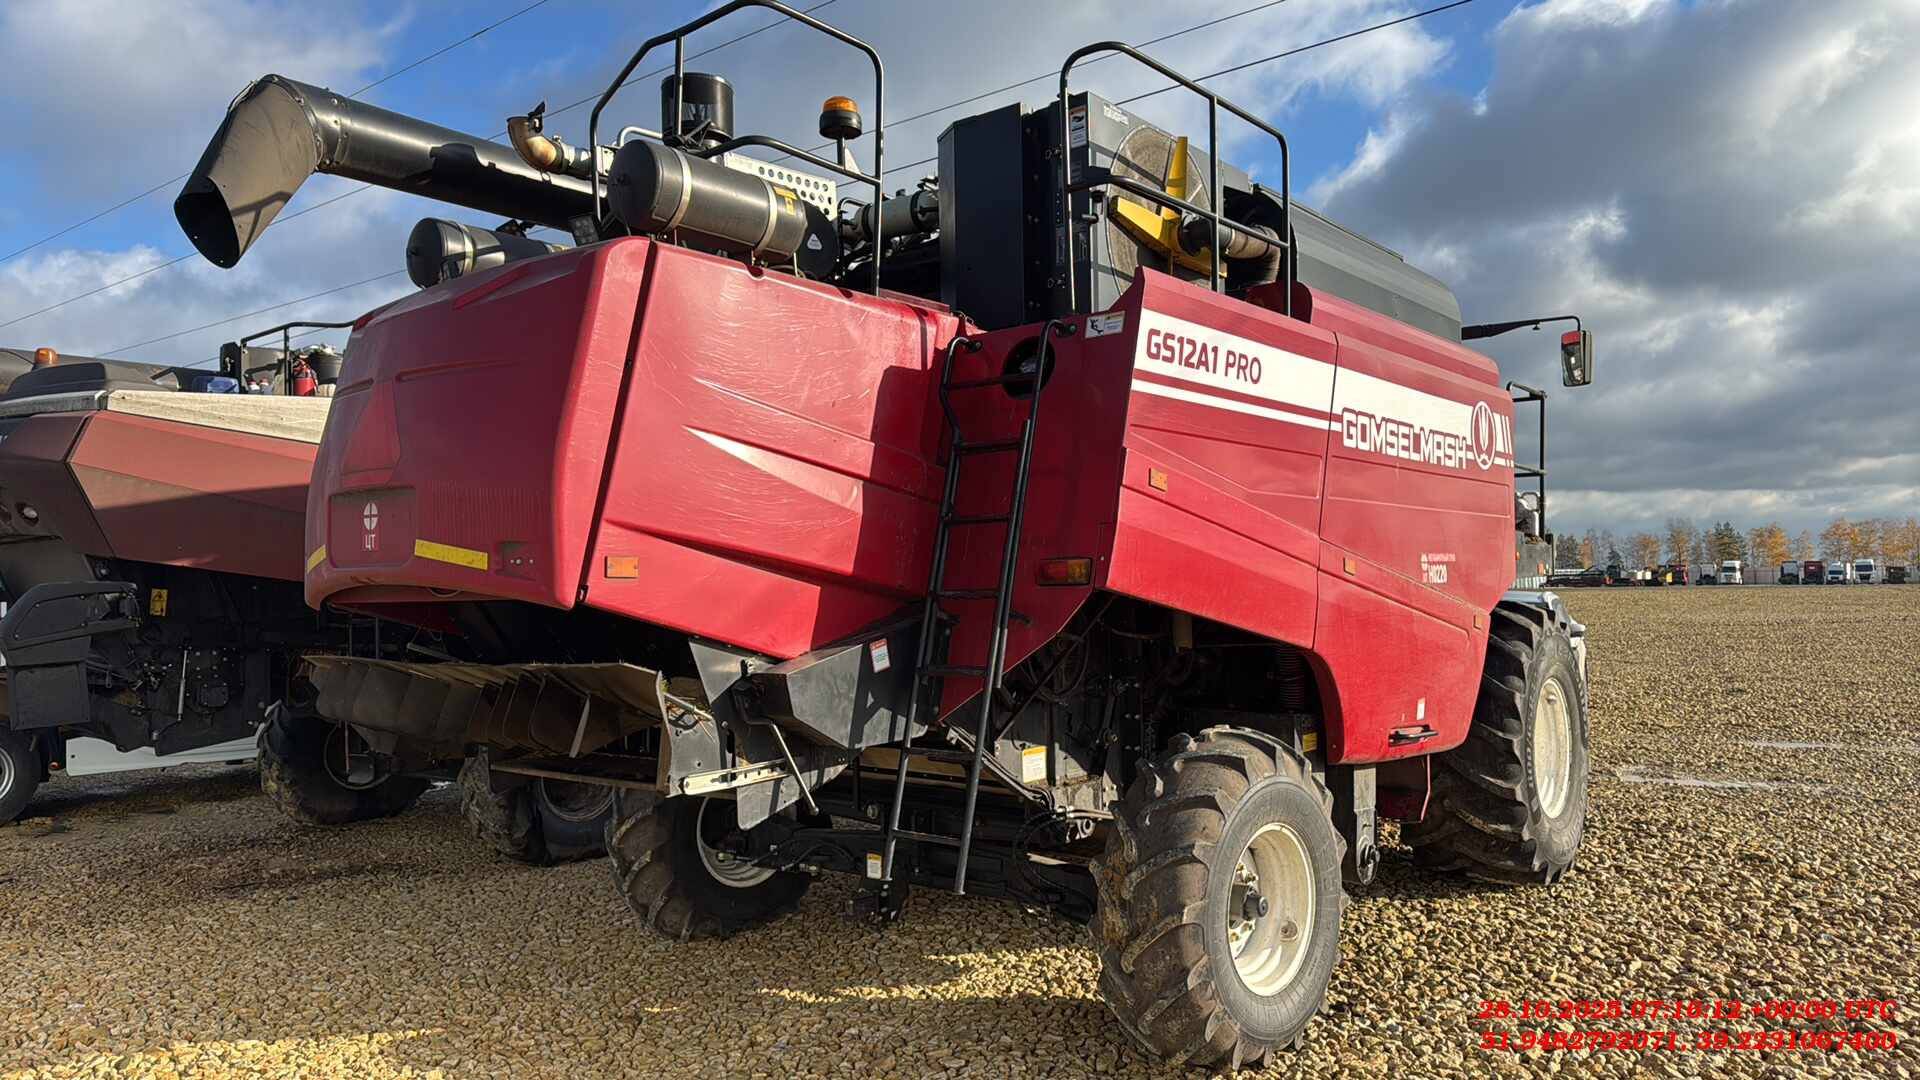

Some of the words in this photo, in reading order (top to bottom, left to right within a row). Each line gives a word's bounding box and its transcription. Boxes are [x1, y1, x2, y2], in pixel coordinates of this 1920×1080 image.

[1147, 328, 1218, 374] GS12A1
[1225, 350, 1262, 385] PRO
[1342, 408, 1466, 470] GOMSELMASH
